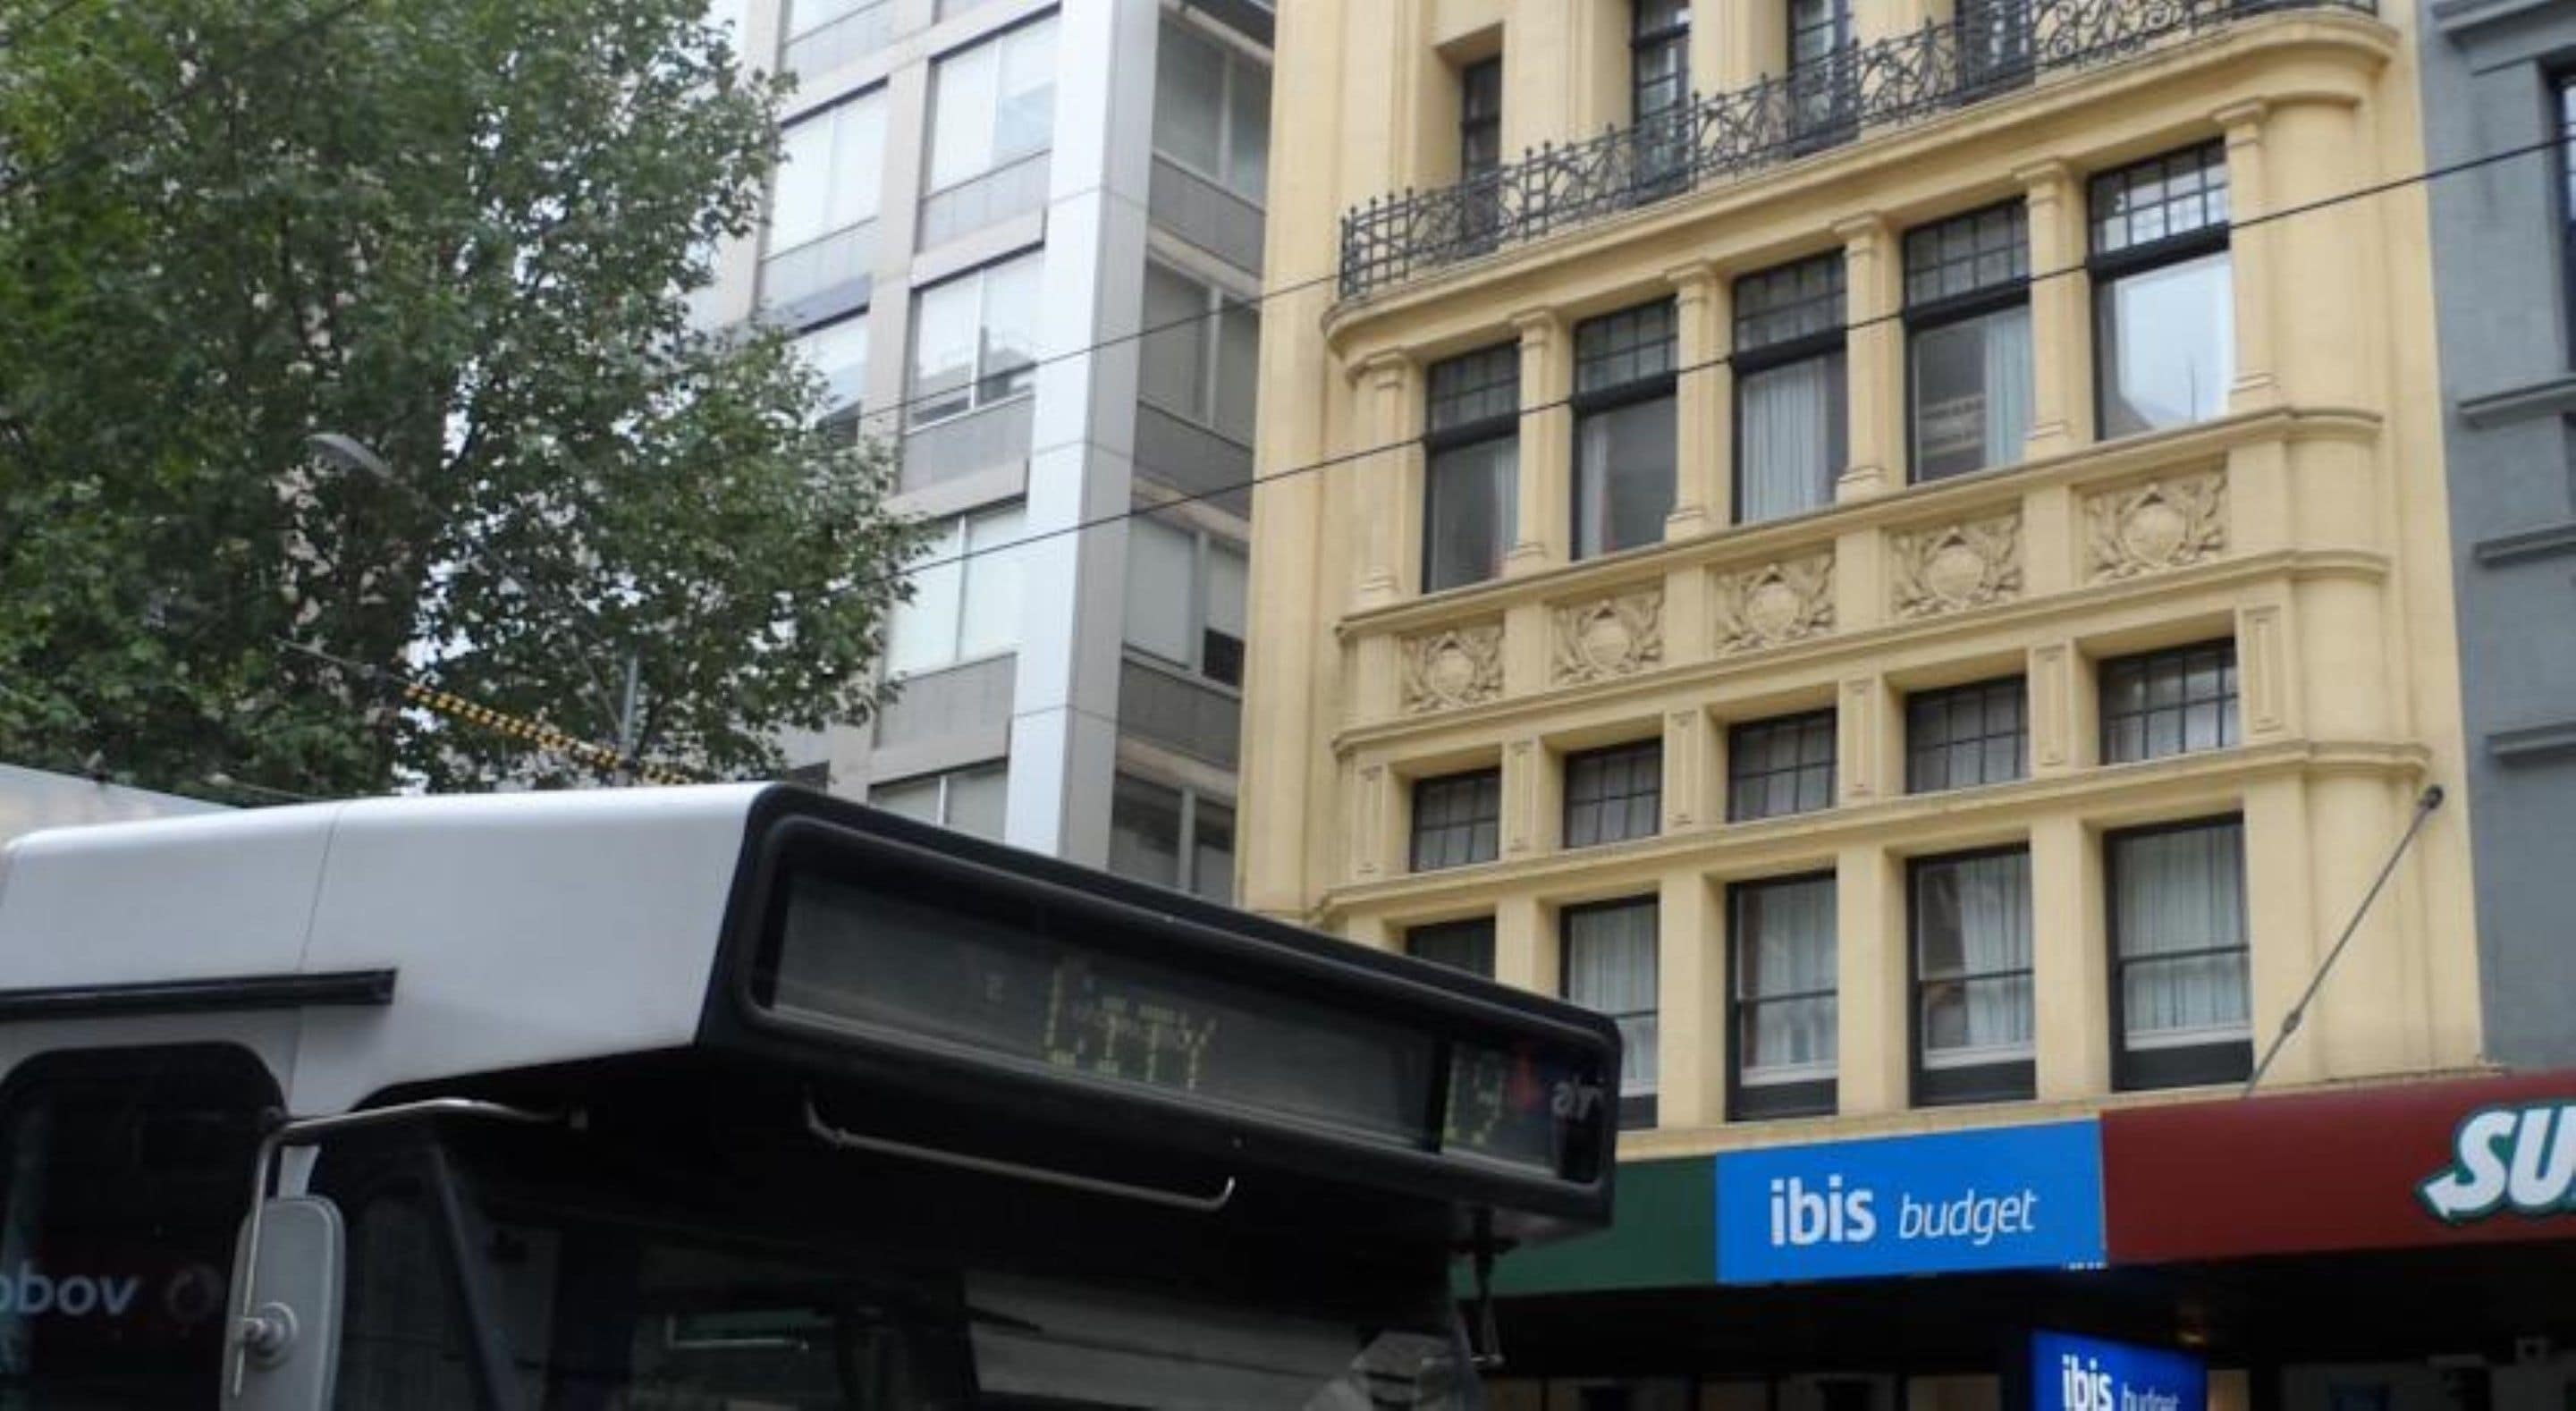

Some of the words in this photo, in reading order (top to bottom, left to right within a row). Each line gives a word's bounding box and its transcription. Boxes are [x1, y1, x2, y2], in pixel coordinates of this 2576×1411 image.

[1769, 1173, 1877, 1246] ibis
[1898, 1188, 2037, 1245] budget
[2062, 1353, 2114, 1411] ibis
